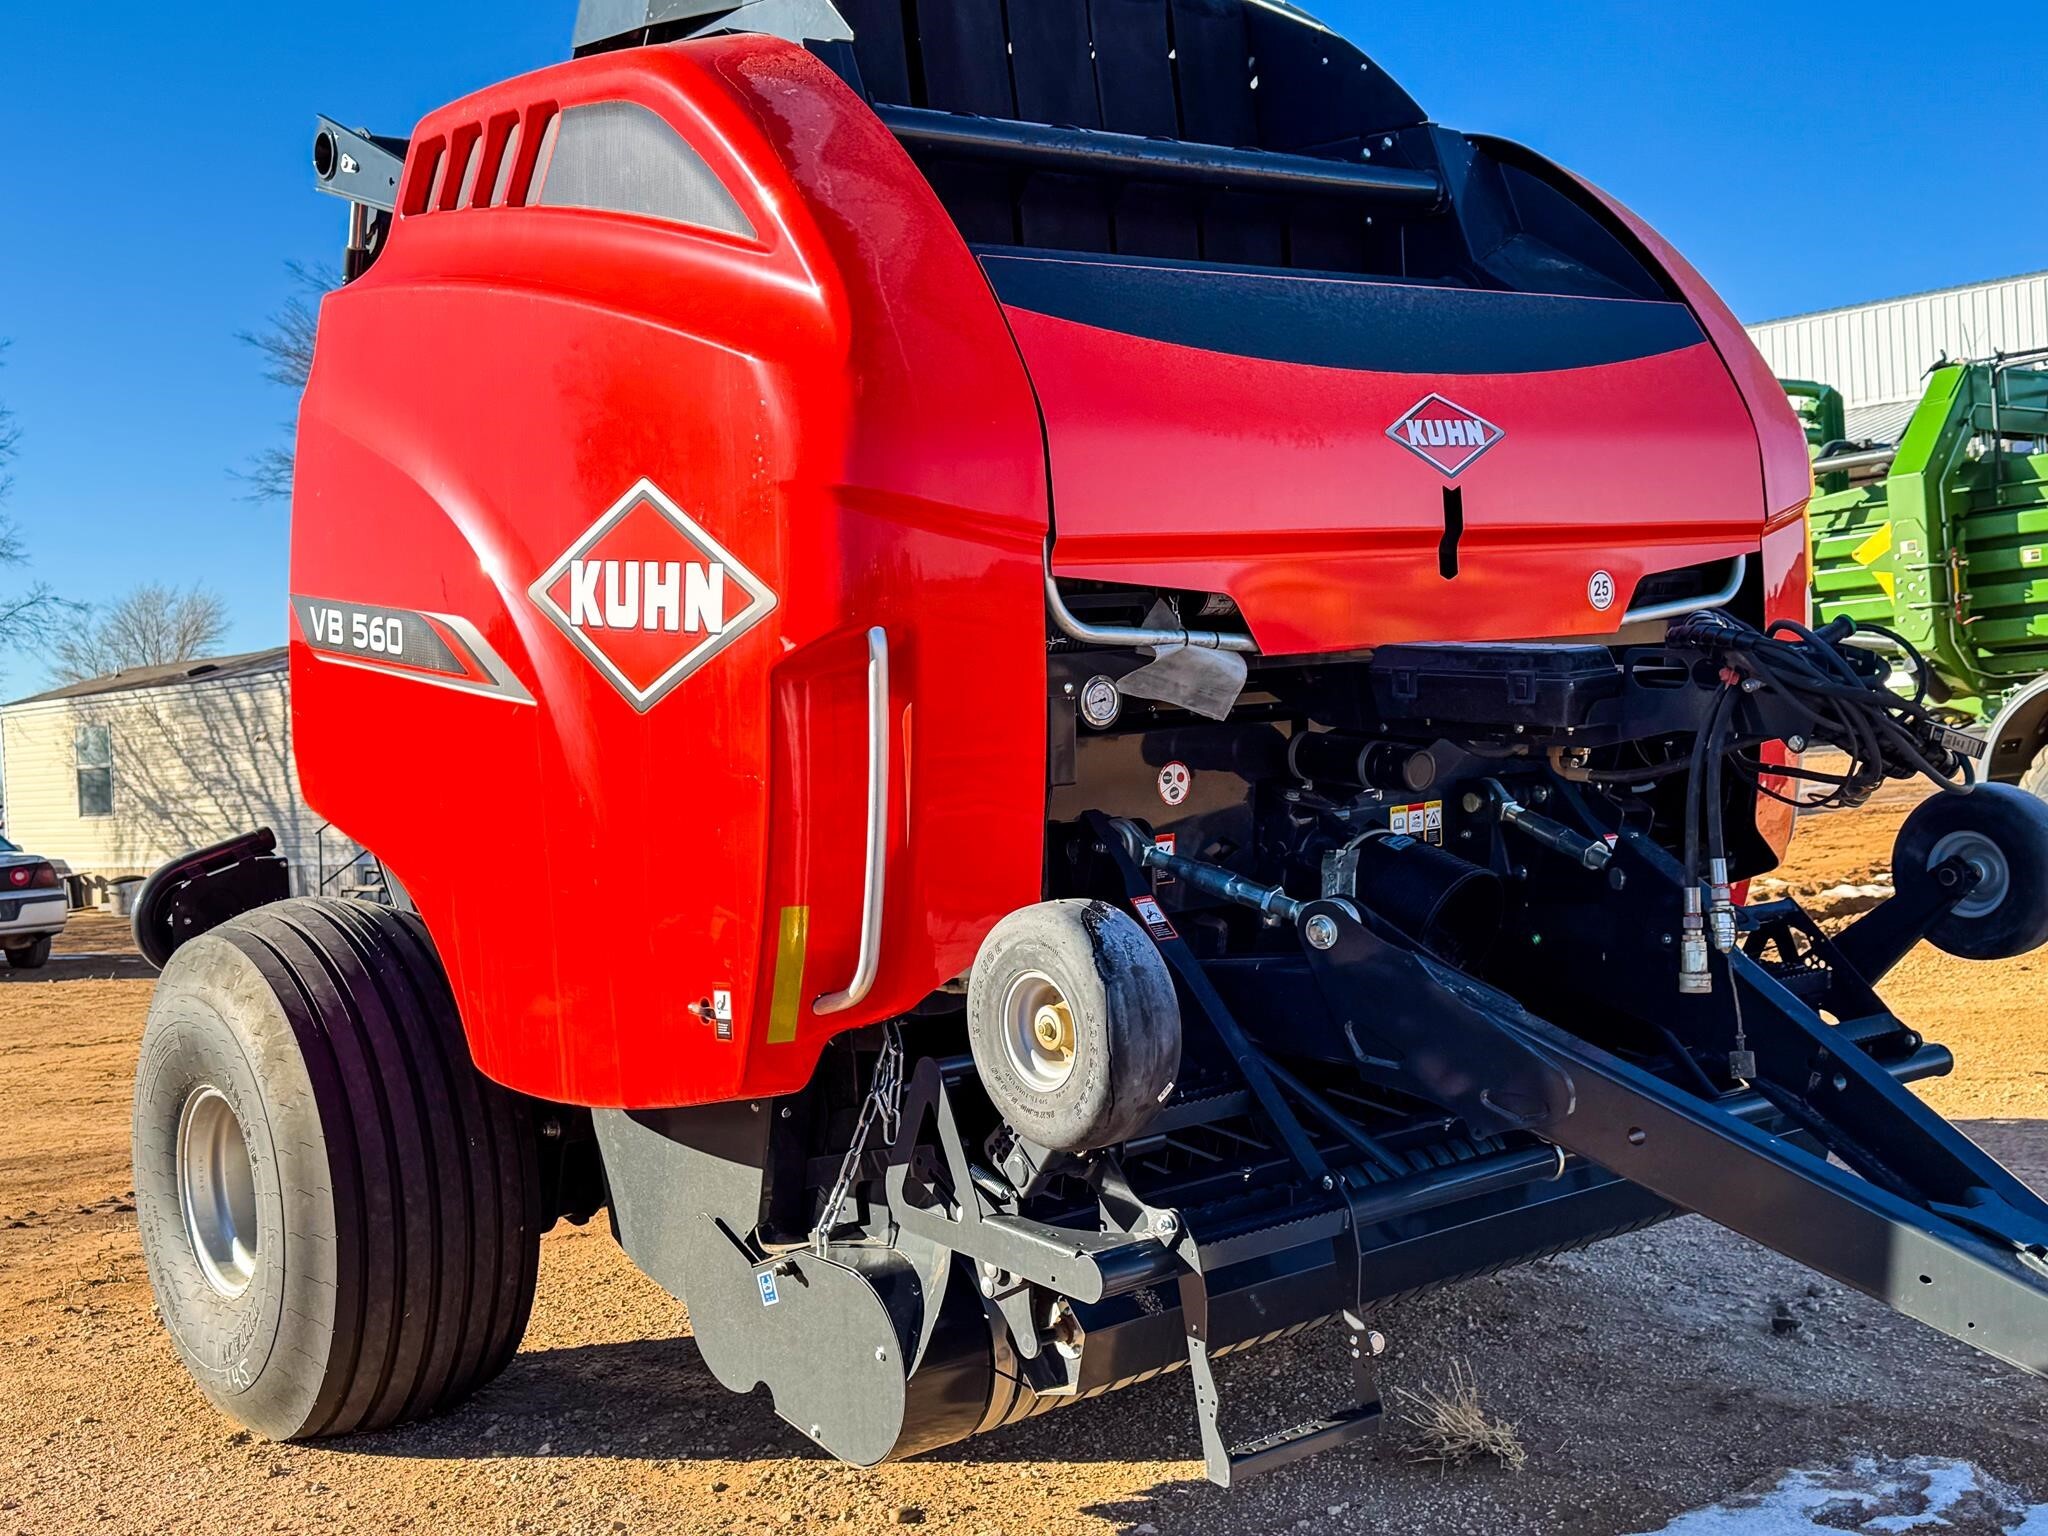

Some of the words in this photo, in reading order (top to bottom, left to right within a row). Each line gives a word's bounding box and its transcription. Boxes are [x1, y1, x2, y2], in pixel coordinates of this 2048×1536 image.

[1405, 419, 1486, 446] KUHN
[570, 559, 724, 635] KUHN
[1593, 580, 1609, 596] 25
[309, 606, 344, 645] VB
[352, 612, 403, 655] 560
